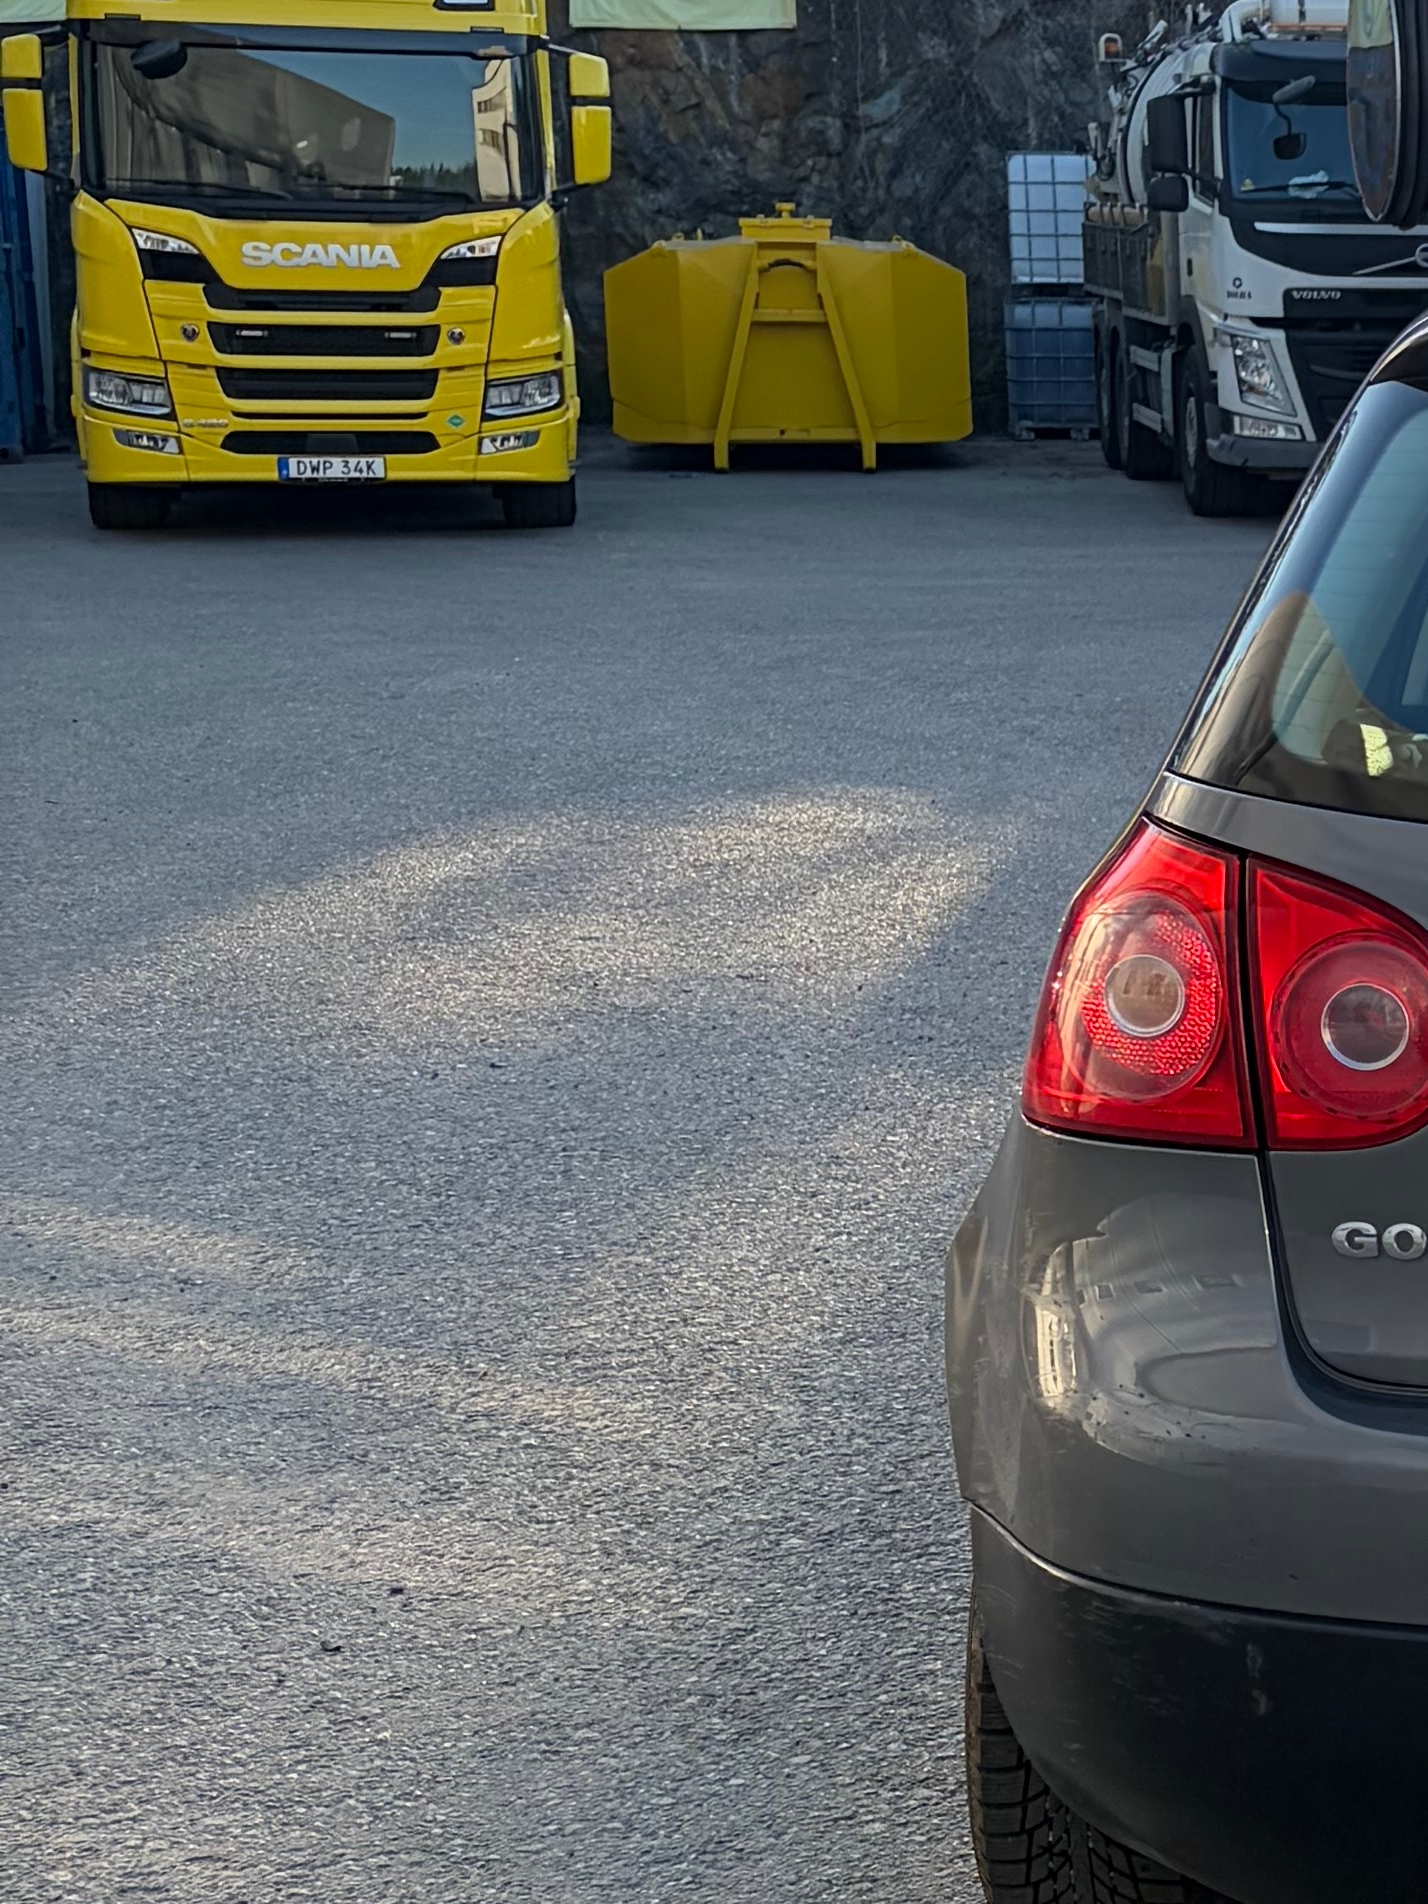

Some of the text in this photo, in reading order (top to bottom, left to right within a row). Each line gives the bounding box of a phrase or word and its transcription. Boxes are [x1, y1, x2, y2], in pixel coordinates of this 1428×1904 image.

[240, 240, 401, 269] SCANIA
[1291, 289, 1341, 300] VOLVO
[296, 459, 334, 476] DWP
[341, 459, 377, 476] 34K
